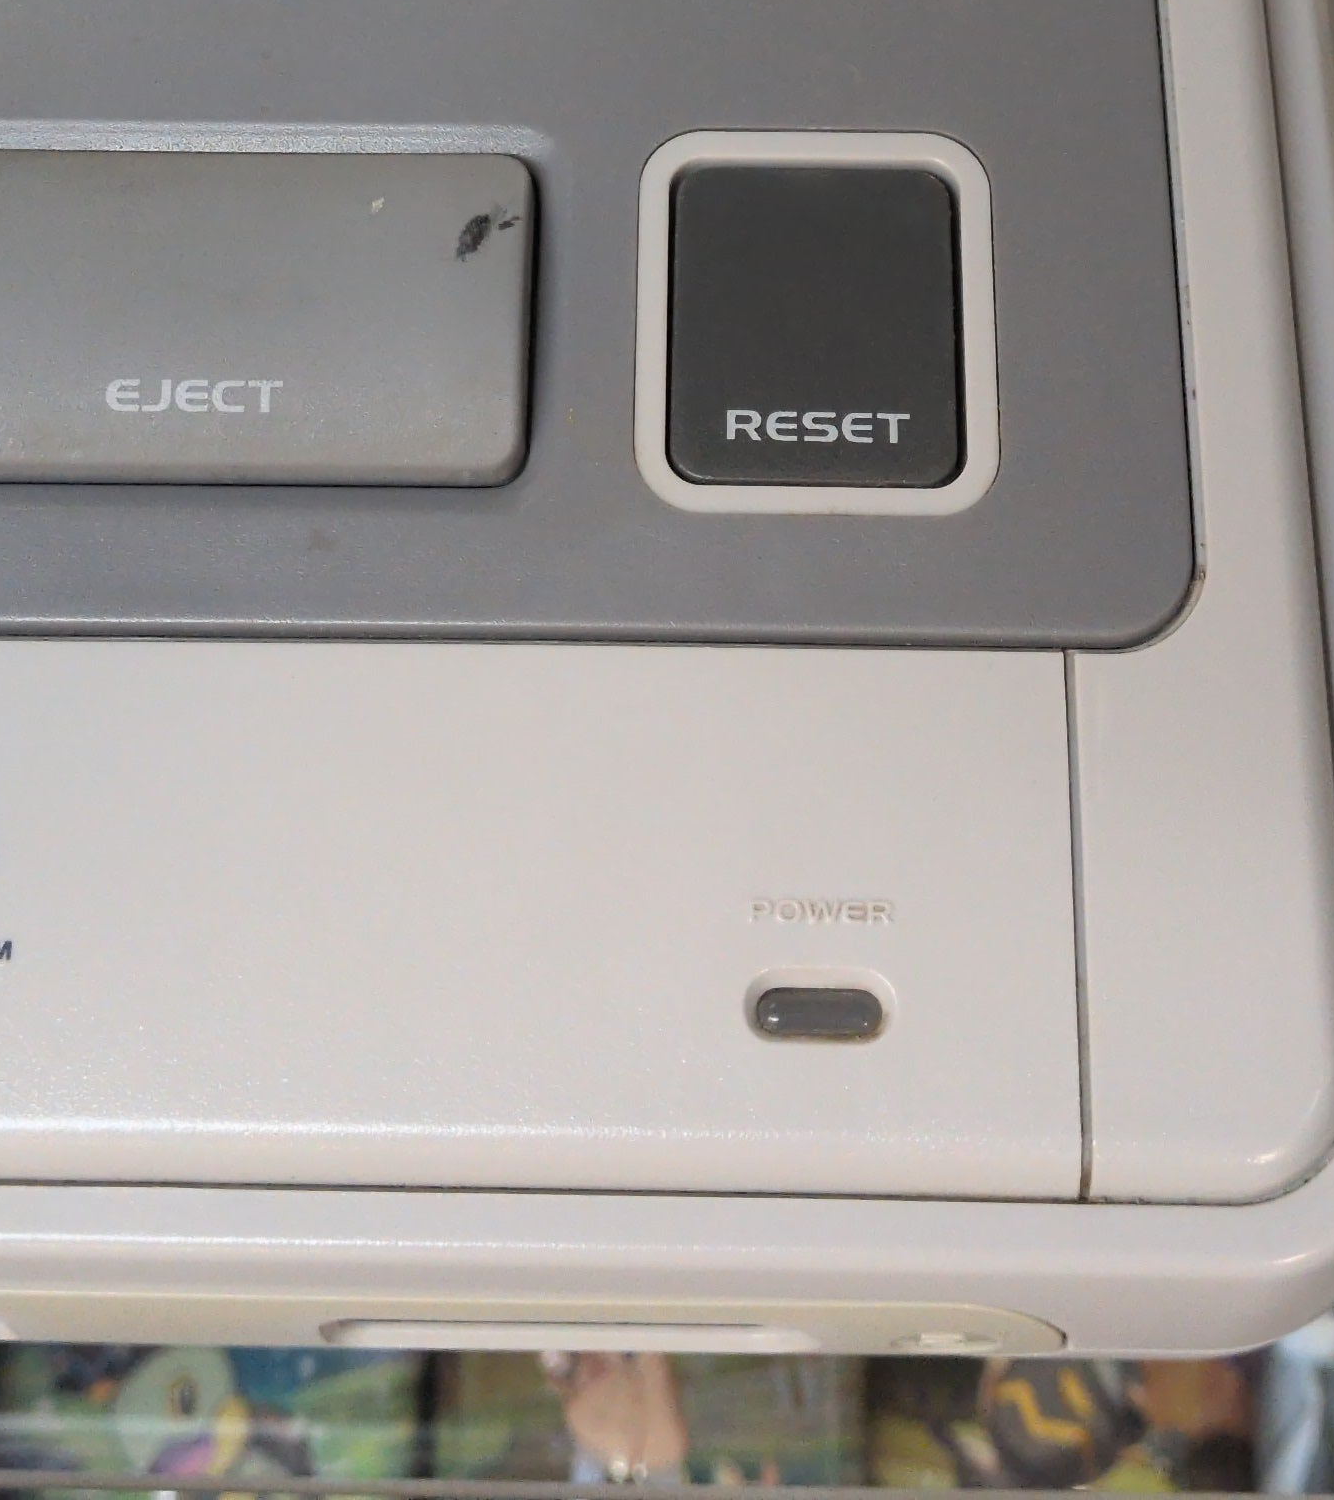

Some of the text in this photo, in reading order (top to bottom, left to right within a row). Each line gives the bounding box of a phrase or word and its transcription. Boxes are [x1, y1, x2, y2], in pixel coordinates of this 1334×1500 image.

[104, 377, 284, 414] EJECT
[725, 408, 911, 445] RESET
[746, 899, 895, 926] POWER
